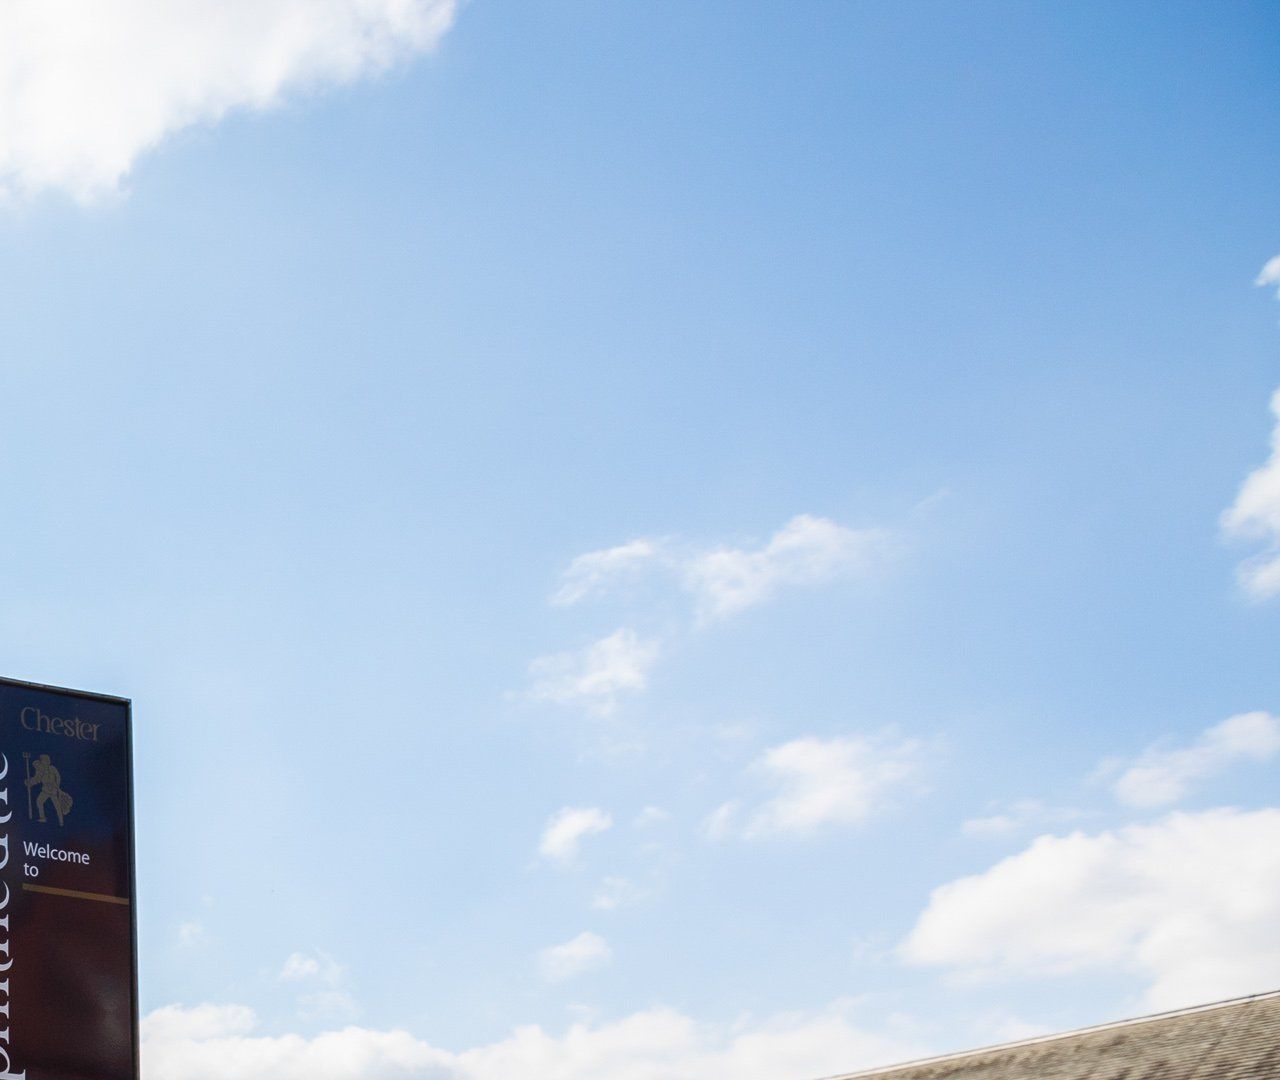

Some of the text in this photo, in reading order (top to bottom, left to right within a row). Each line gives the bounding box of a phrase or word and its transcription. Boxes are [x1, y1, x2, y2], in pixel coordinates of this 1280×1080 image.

[20, 706, 102, 741] Chester
[23, 840, 90, 865] Welcome
[23, 862, 39, 878] to
